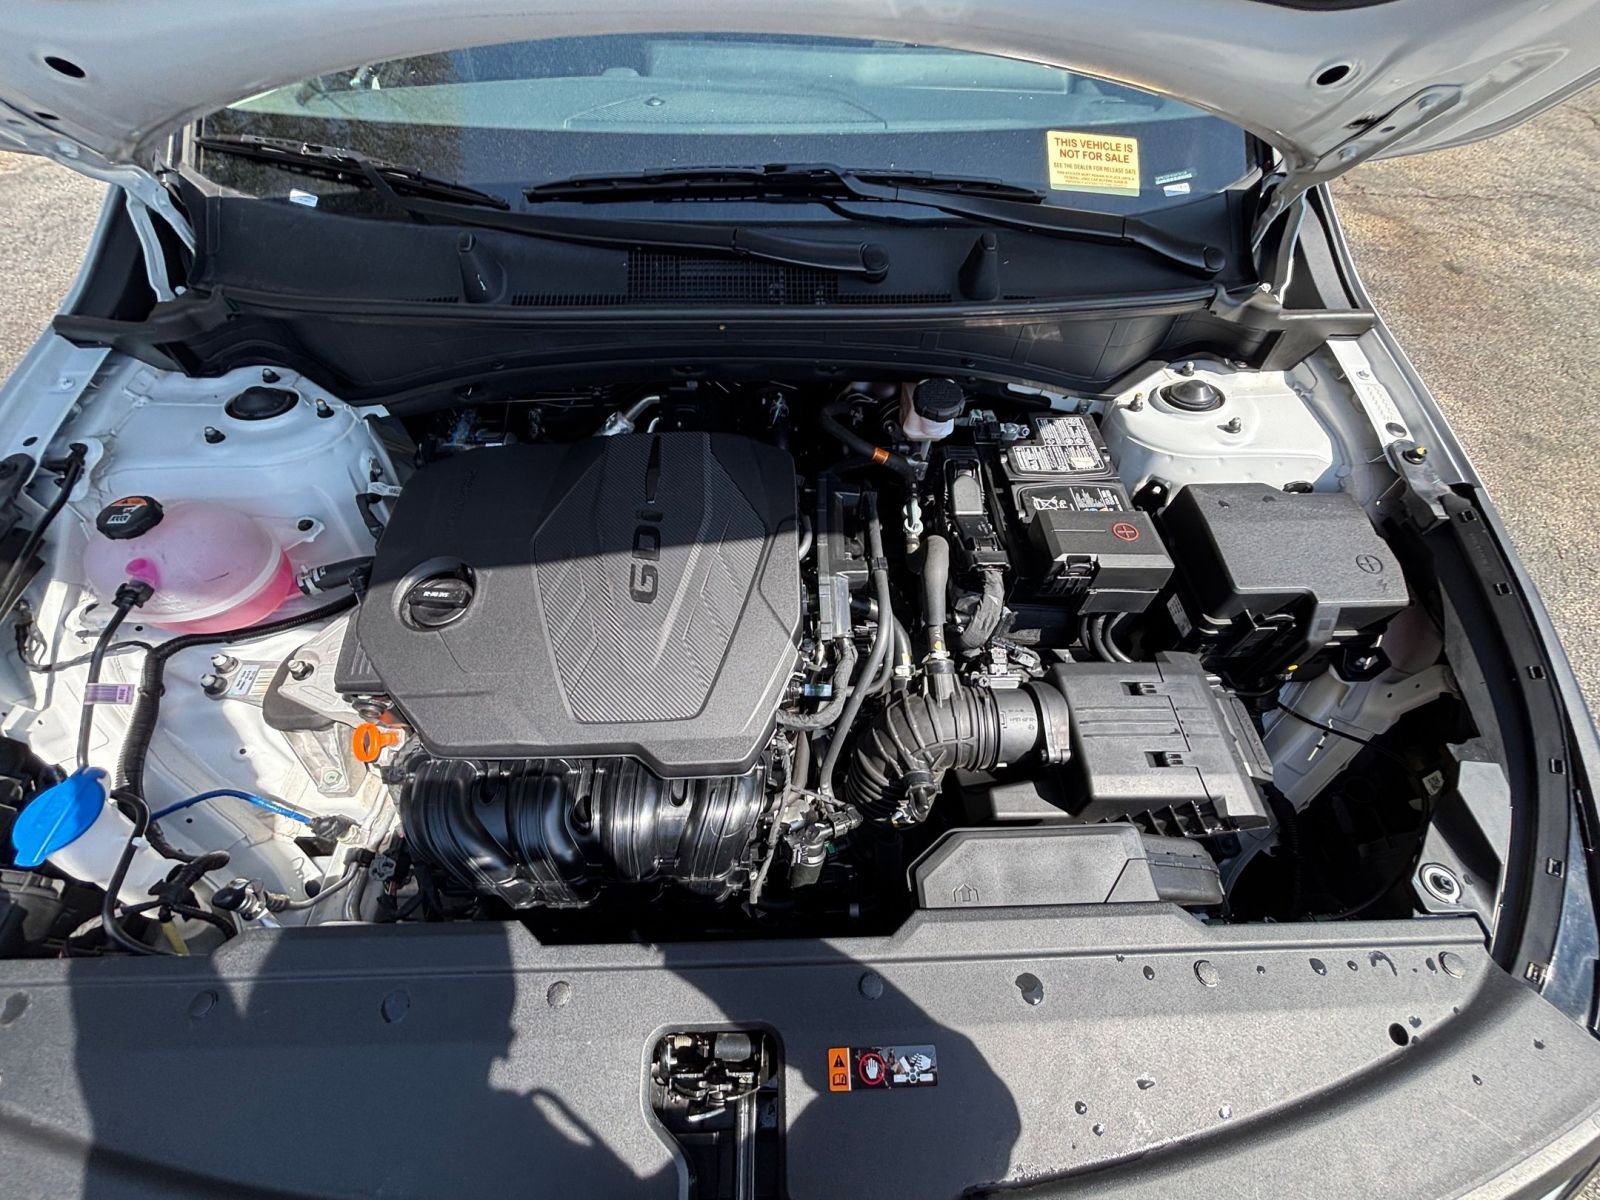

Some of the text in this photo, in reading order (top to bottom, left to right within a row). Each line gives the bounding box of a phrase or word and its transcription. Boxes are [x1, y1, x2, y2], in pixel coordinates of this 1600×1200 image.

[1054, 137, 1133, 152] THIS VEHICLE IS
[1060, 149, 1130, 163] NOT FOR SALE
